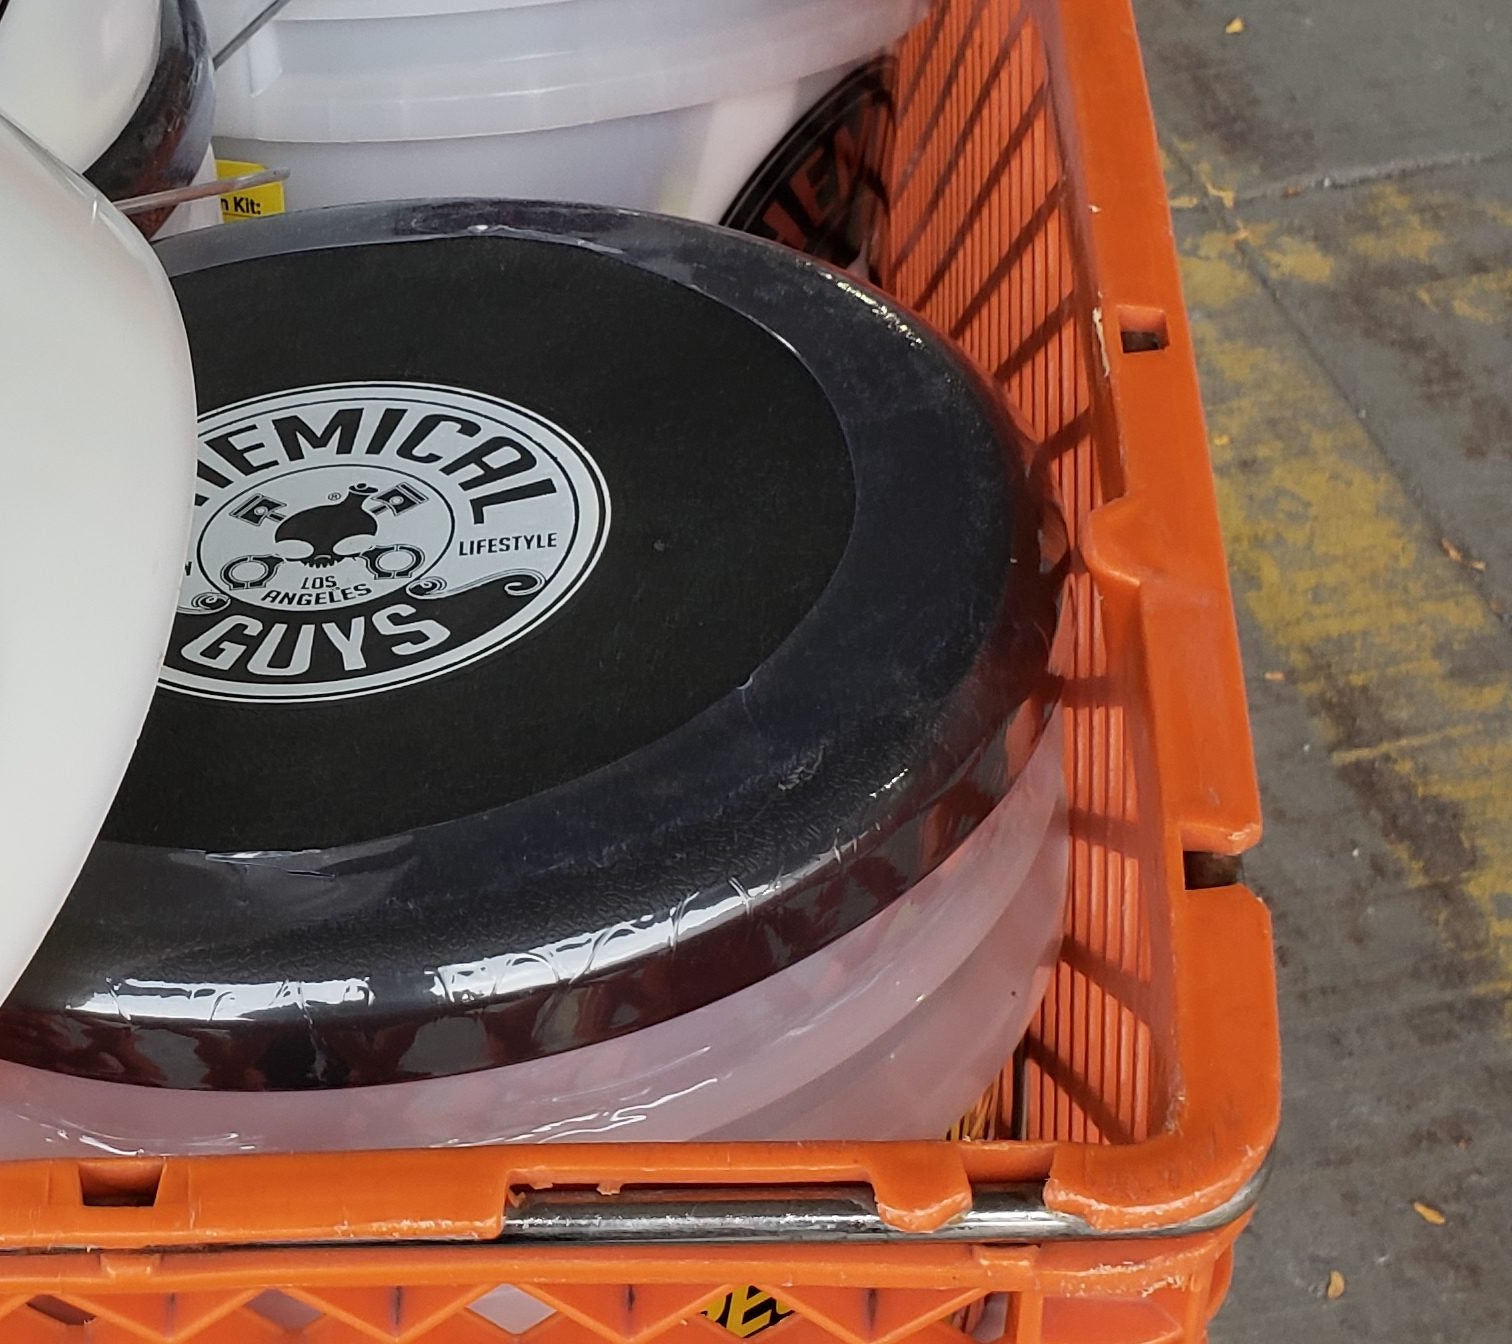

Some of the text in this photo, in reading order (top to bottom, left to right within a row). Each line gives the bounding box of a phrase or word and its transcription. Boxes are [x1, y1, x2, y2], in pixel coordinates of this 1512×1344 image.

[233, 197, 261, 215] Kit:
[194, 407, 557, 526] EMICAL
[458, 532, 558, 557] LIFESTYLE
[300, 575, 338, 590] LOS
[261, 583, 373, 607] ANGELES
[180, 603, 452, 676] GUYS
